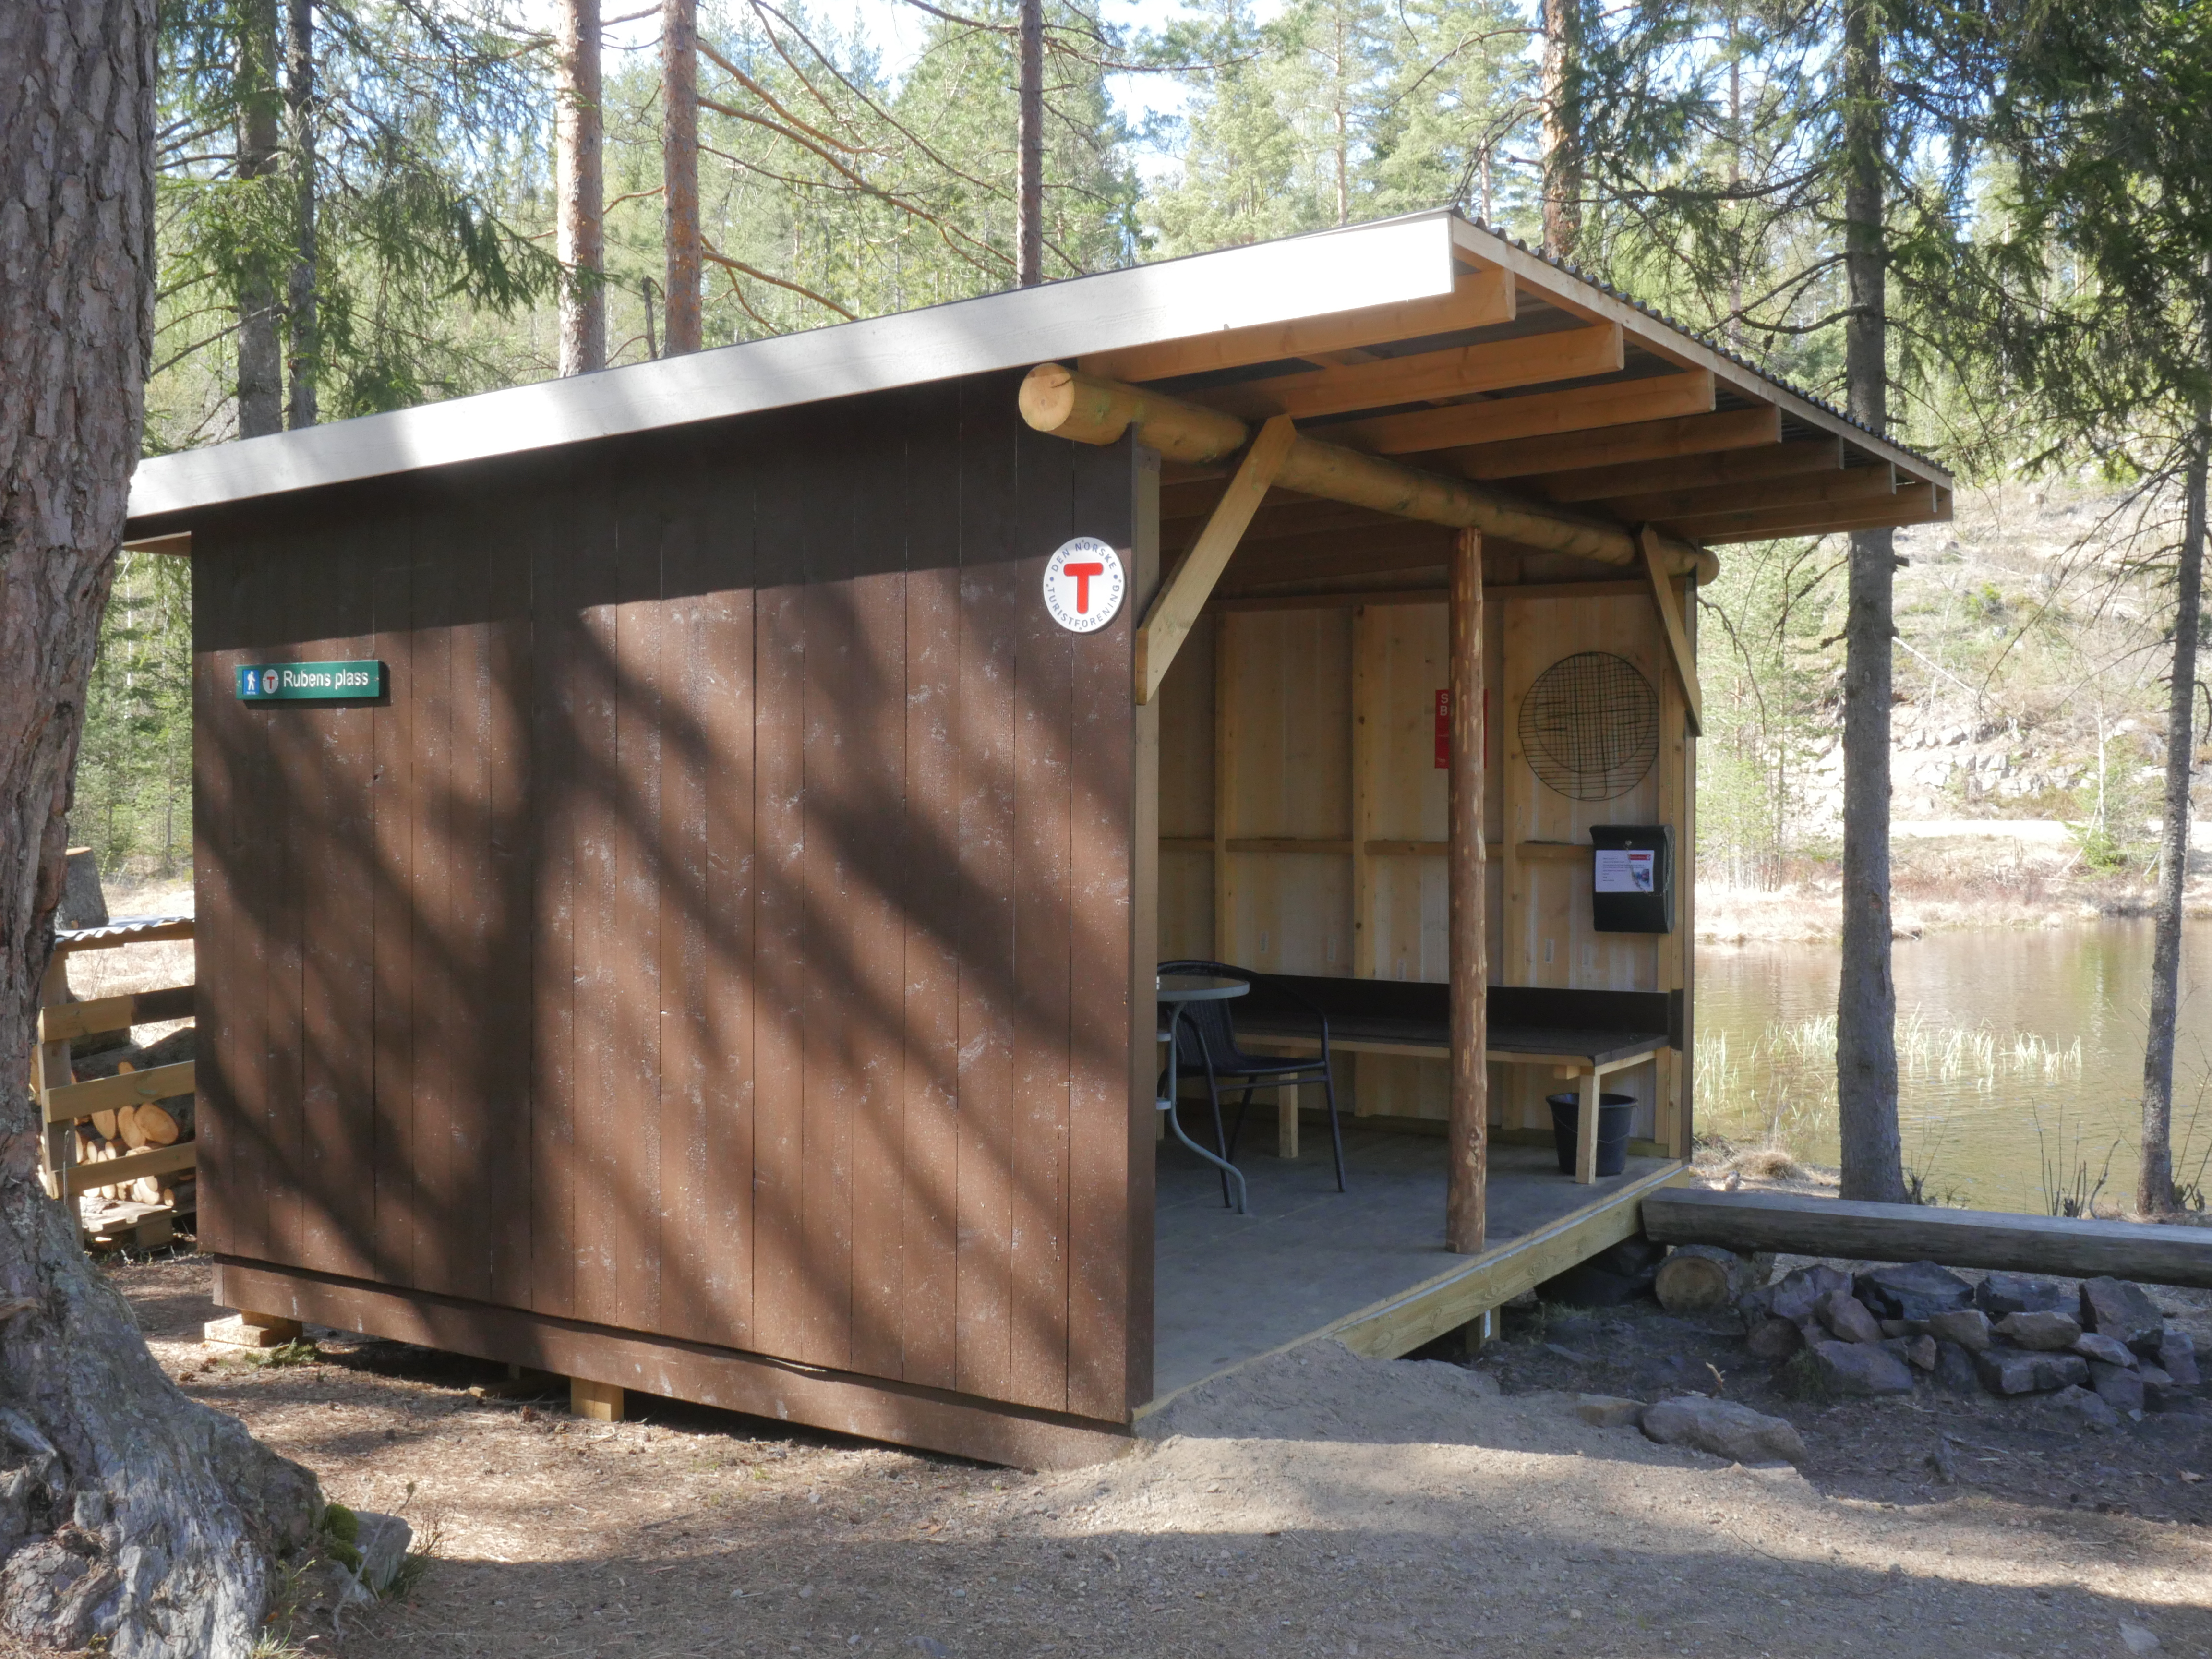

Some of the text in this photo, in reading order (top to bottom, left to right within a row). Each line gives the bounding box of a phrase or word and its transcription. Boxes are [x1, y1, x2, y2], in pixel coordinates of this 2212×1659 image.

[1051, 542, 1117, 572] DEN NORSKE
[1063, 562, 1104, 614] T
[1047, 584, 1120, 628] TURISTFORENING
[267, 676, 275, 689] T
[283, 669, 369, 690] Rubens plass
